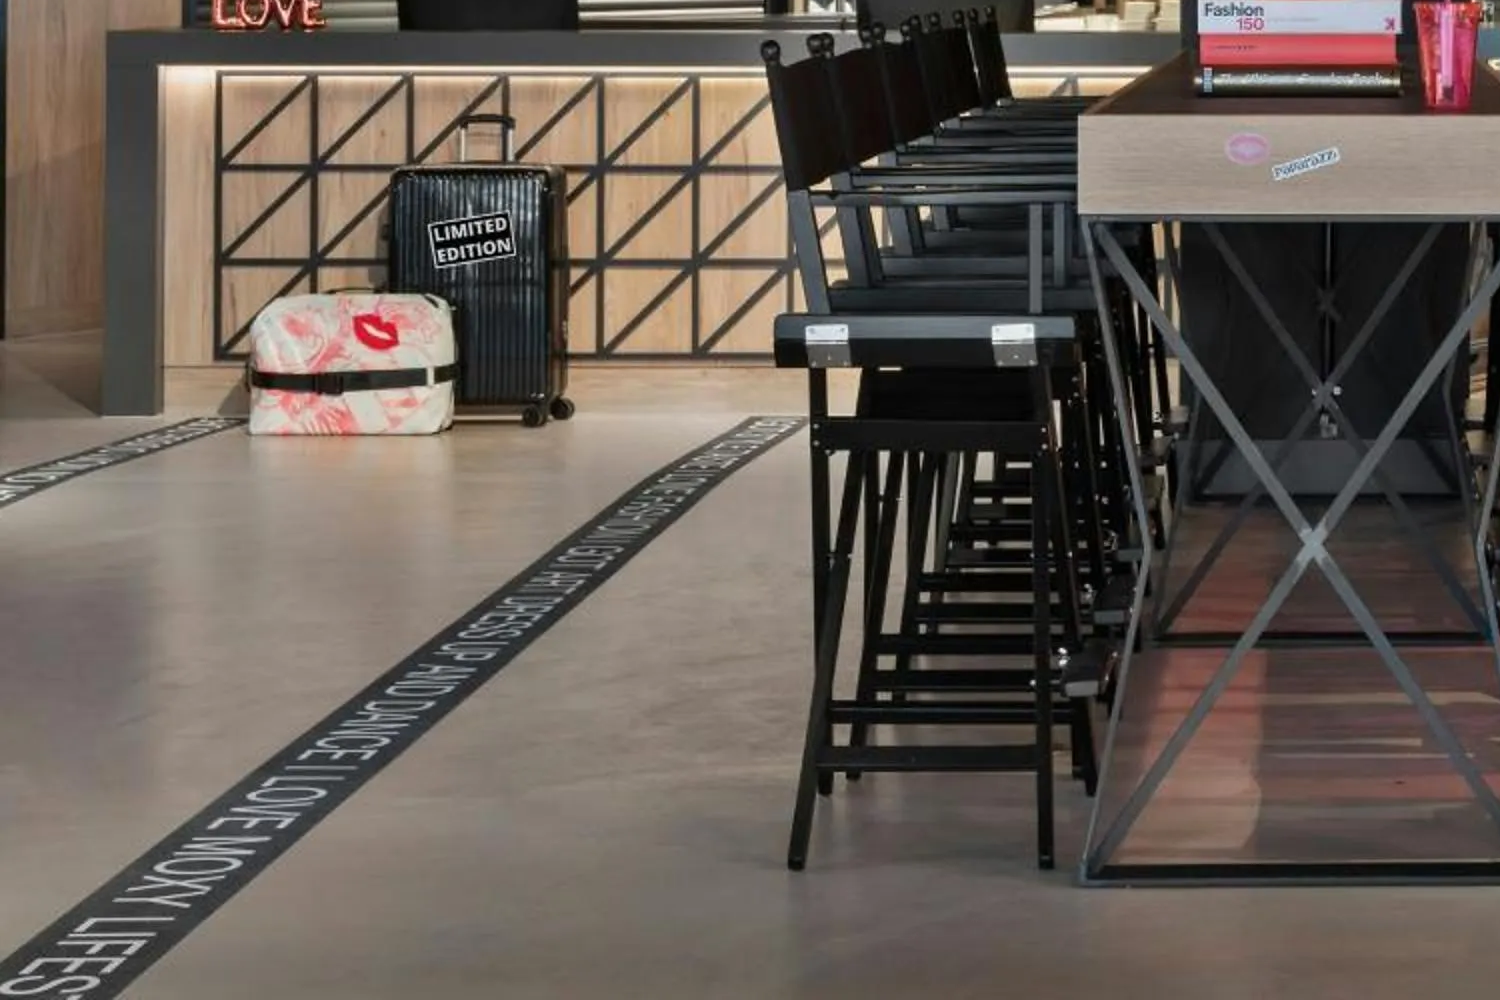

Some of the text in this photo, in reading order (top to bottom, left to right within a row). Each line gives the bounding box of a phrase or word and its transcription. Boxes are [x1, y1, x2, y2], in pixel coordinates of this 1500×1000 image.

[1204, 2, 1264, 18] Fashion
[1236, 18, 1265, 31] 150
[433, 217, 507, 243] LIMITED
[437, 238, 512, 263] EDITION
[457, 597, 564, 639] DRESS
[433, 641, 510, 661] UP
[385, 664, 477, 697] AND
[297, 700, 436, 760] DANCE
[206, 776, 345, 830] LOVE
[112, 836, 272, 908] MOXY
[0, 916, 176, 1000] LIFES
